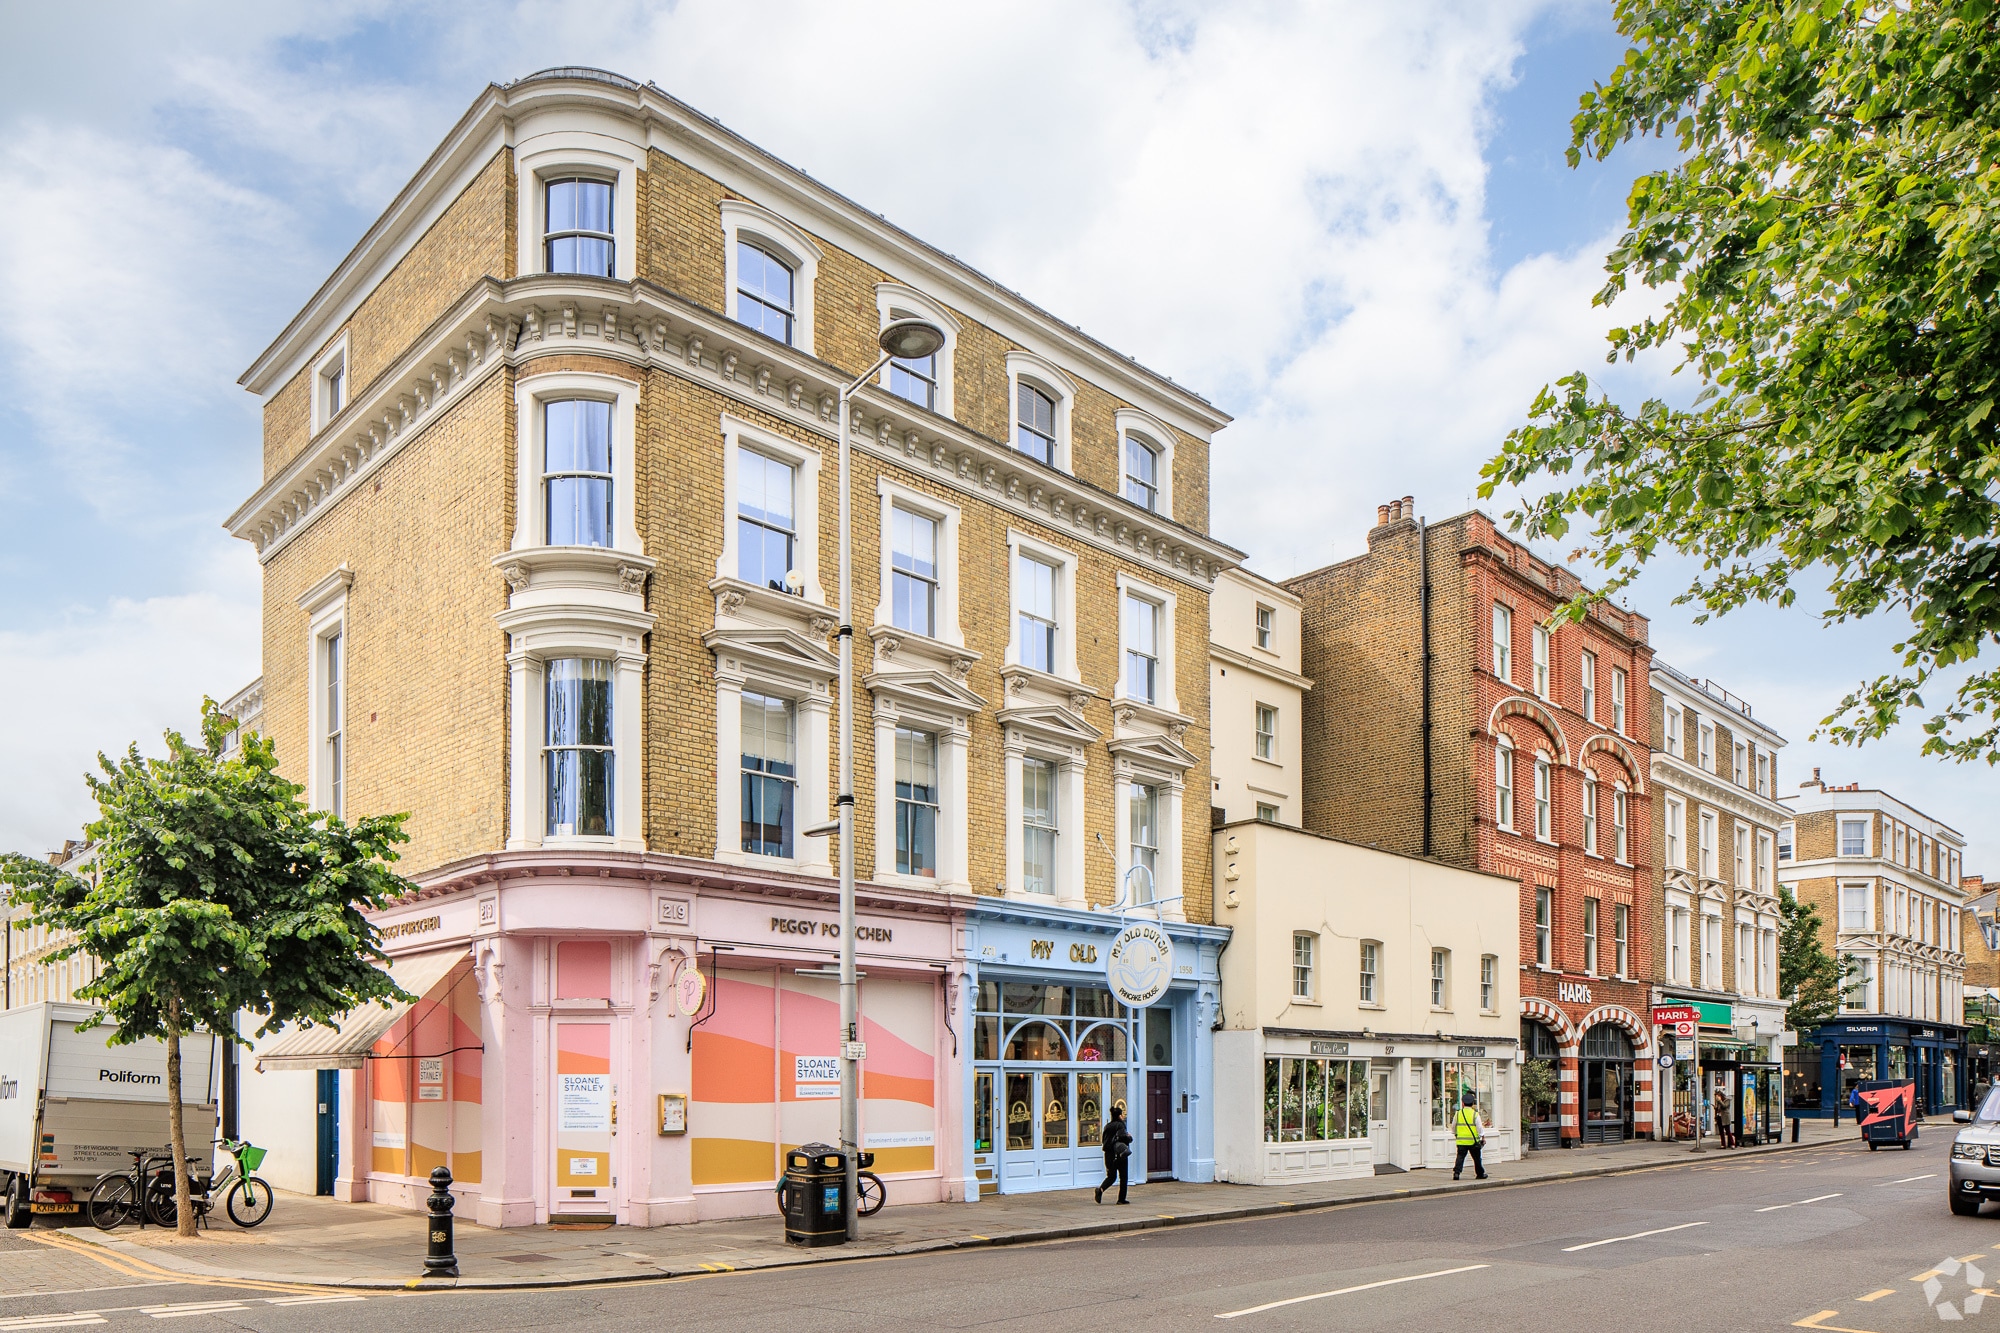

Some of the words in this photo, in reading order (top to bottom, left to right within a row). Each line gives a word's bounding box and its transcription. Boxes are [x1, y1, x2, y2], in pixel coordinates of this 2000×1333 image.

[480, 904, 493, 920] 219
[663, 904, 685, 920] 219
[381, 924, 400, 940] EGGY
[400, 916, 440, 936] PORSCHEN
[772, 918, 818, 934] PEGGY
[822, 922, 892, 942] POCHEN
[1112, 940, 1123, 958] MY
[1124, 928, 1141, 943] OLD
[1144, 928, 1168, 956] DUTCH
[1032, 940, 1054, 960] MY
[1070, 943, 1098, 963] OLD
[1179, 966, 1192, 974] 1958
[1119, 987, 1141, 1002] PANCAKE
[1142, 985, 1159, 1000] HOUSE
[1558, 982, 1592, 1004] HARI's
[1656, 1011, 1688, 1020] HARI's
[420, 1061, 440, 1070] SLOANE
[798, 1060, 836, 1068] SLOANE
[100, 1070, 160, 1084] Poliform
[420, 1072, 442, 1080] STANLEY
[798, 1070, 840, 1078] STANLEY
[36, 1204, 54, 1212] KX19
[57, 1204, 74, 1212] PXN
